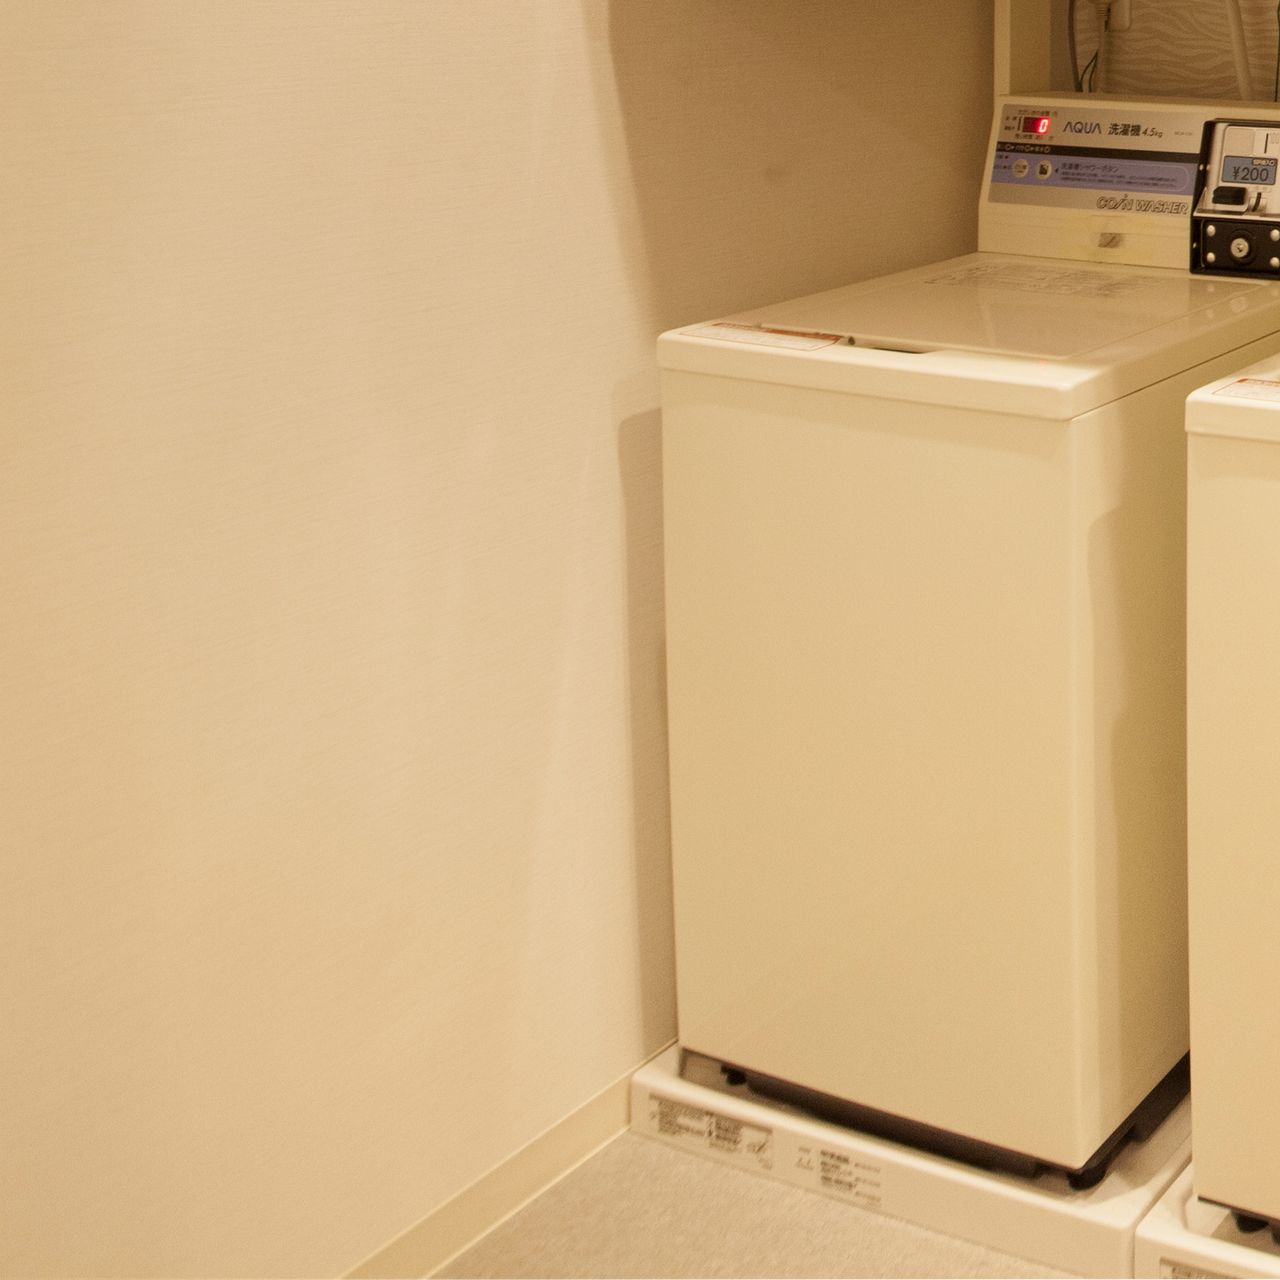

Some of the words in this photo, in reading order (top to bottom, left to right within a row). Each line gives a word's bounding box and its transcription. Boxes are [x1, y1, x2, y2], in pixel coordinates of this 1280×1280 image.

[1039, 119, 1048, 132] 0
[1062, 121, 1102, 135] AQUA
[1108, 123, 1142, 137] 洗濯機
[1232, 166, 1269, 182] ¥200
[1135, 198, 1188, 215] WASHER
